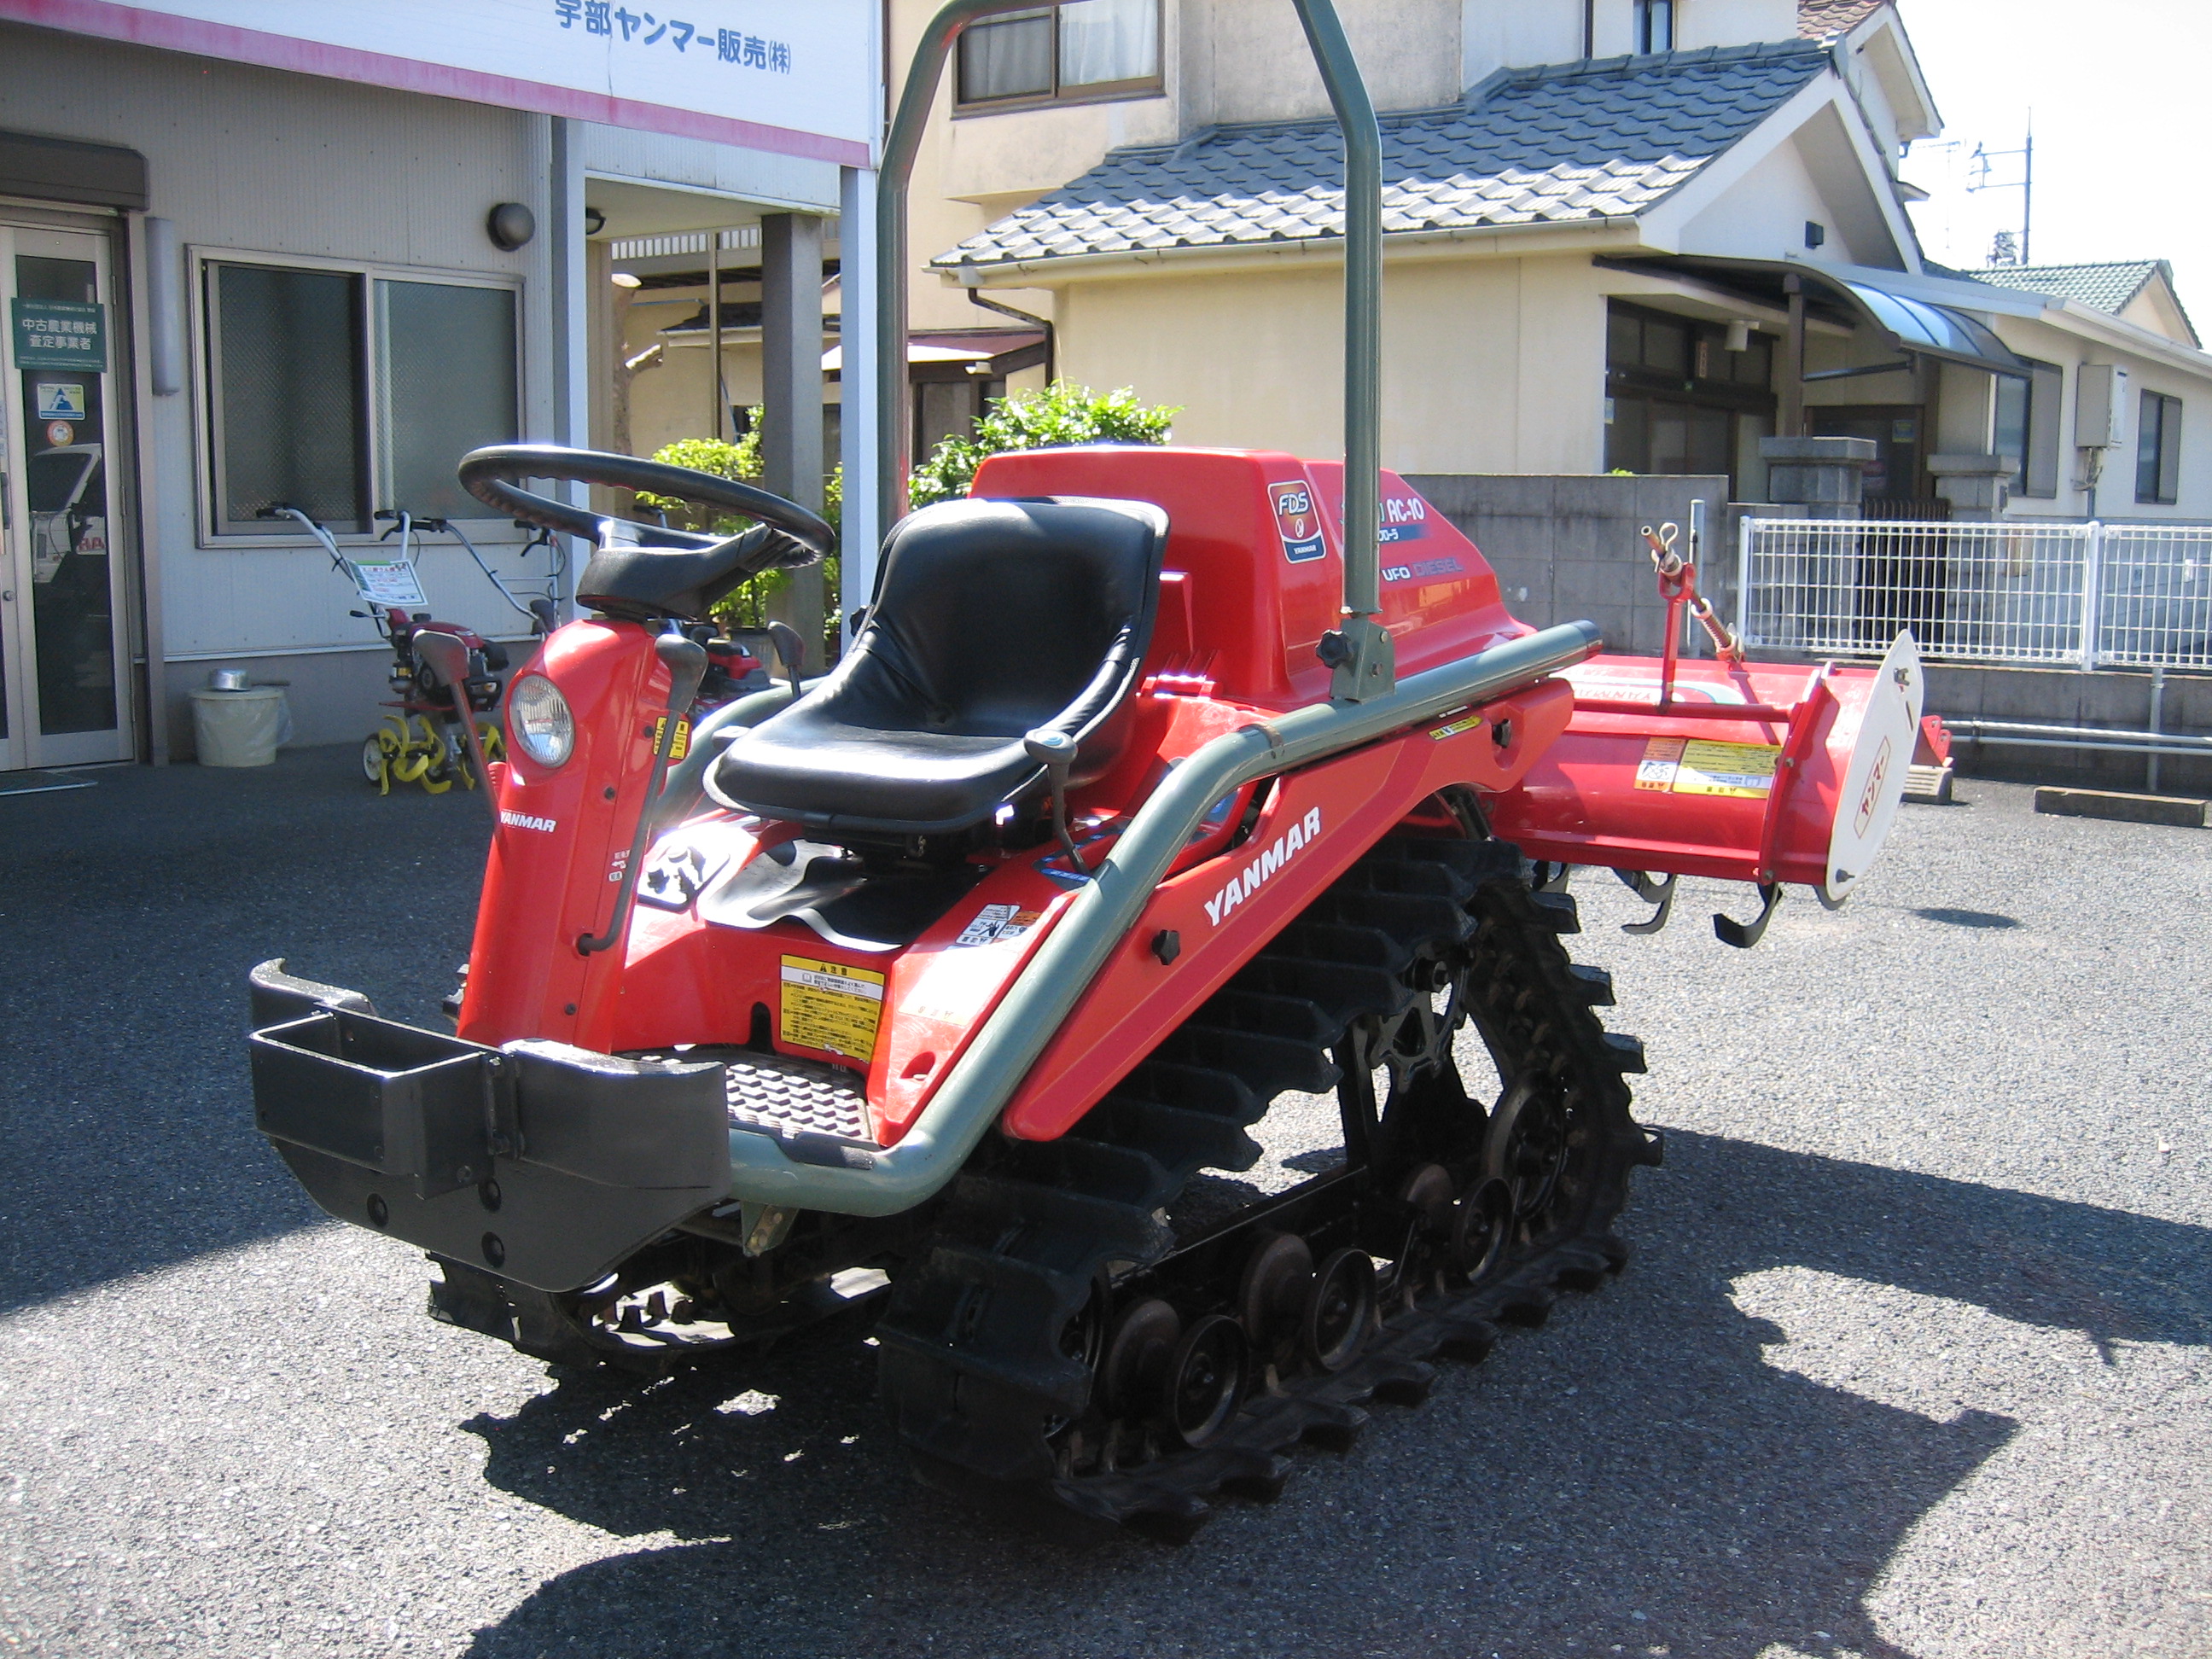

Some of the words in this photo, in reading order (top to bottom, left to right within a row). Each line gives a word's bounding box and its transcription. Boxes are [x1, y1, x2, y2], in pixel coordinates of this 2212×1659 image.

[1278, 492, 1309, 515] FDS
[1386, 498, 1425, 522] AC-10
[1382, 567, 1411, 581] UFO
[1412, 558, 1464, 578] DIESEL
[1861, 755, 1884, 816] ヤンマー
[500, 811, 556, 833] YANMAR
[1203, 806, 1321, 927] YANMAR
